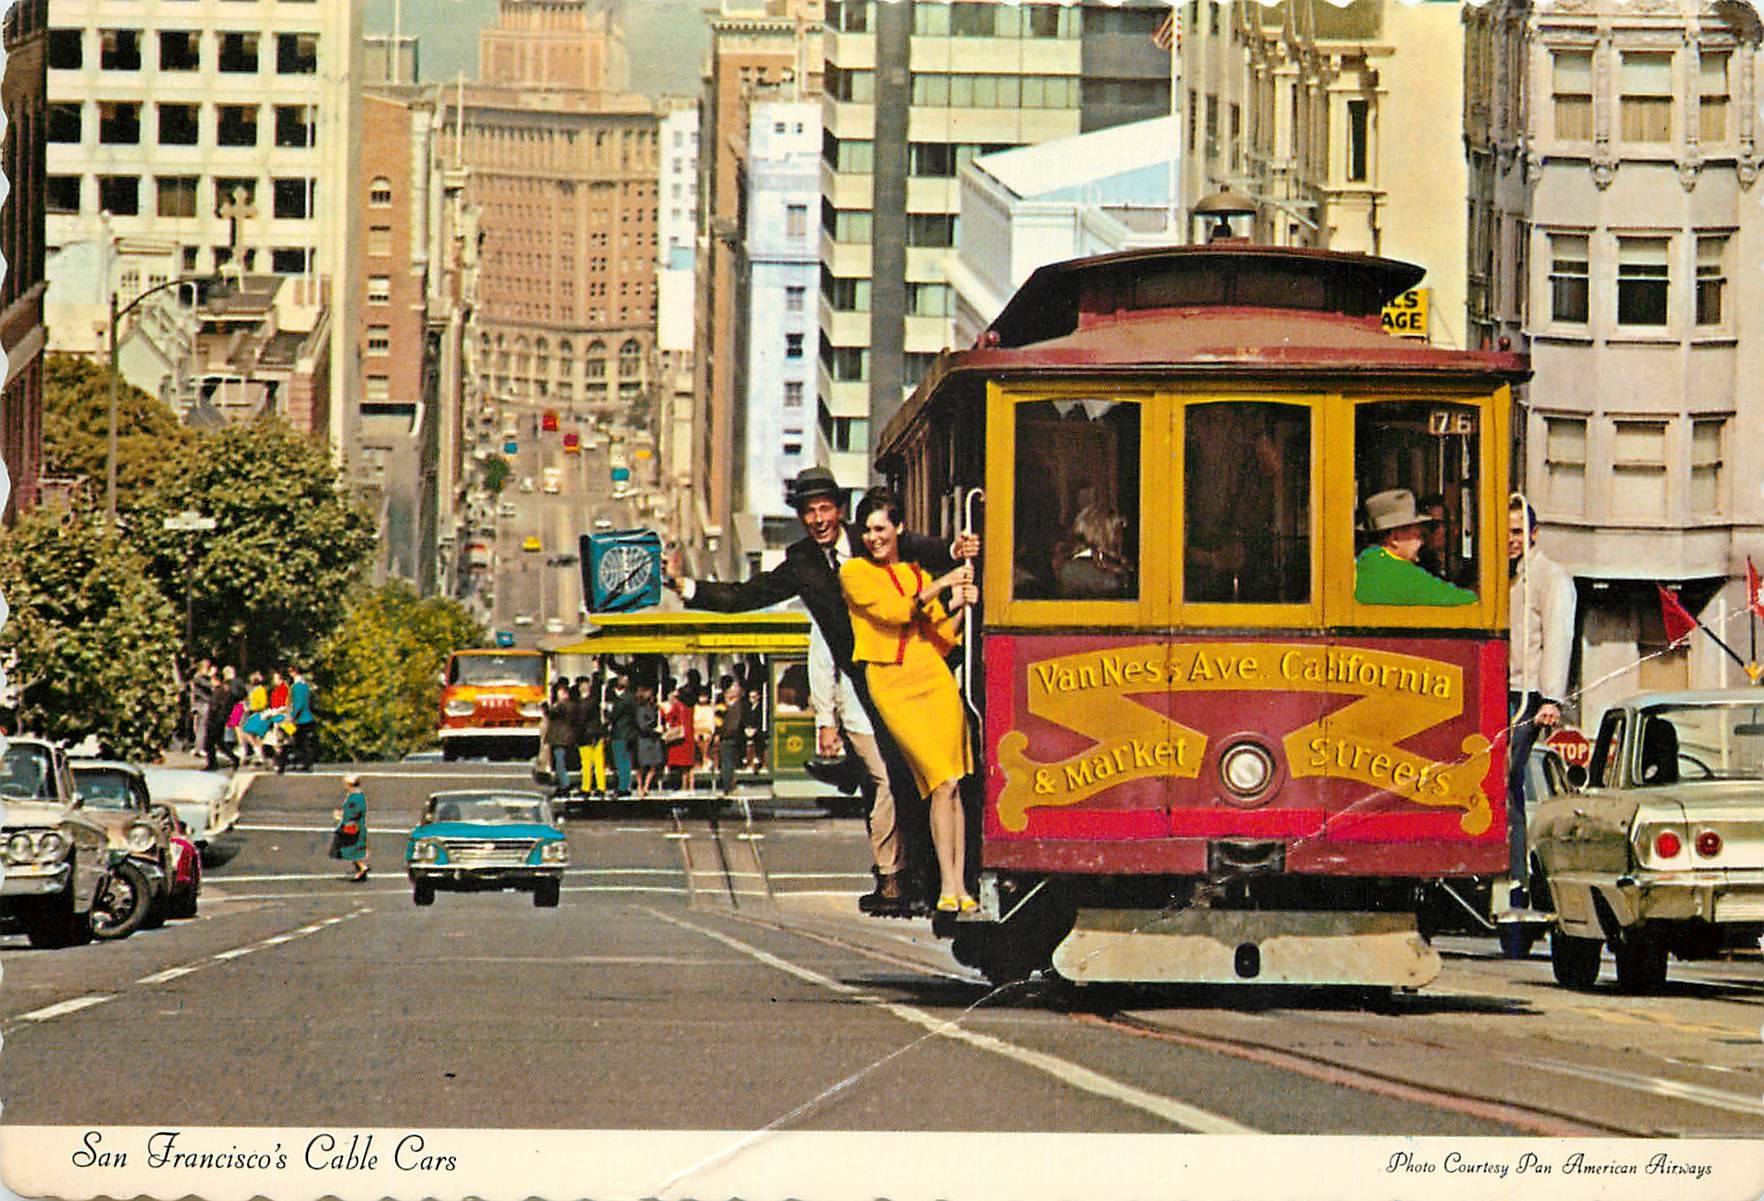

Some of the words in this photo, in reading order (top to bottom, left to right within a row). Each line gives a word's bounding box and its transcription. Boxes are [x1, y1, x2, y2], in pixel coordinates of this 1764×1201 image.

[1382, 312, 1421, 329] AGE
[1036, 662, 1097, 695] Van
[1101, 654, 1183, 687] Ness
[1281, 650, 1450, 699] California
[1034, 768, 1055, 794] &
[1064, 738, 1185, 791] Market
[1309, 737, 1451, 796] Streets
